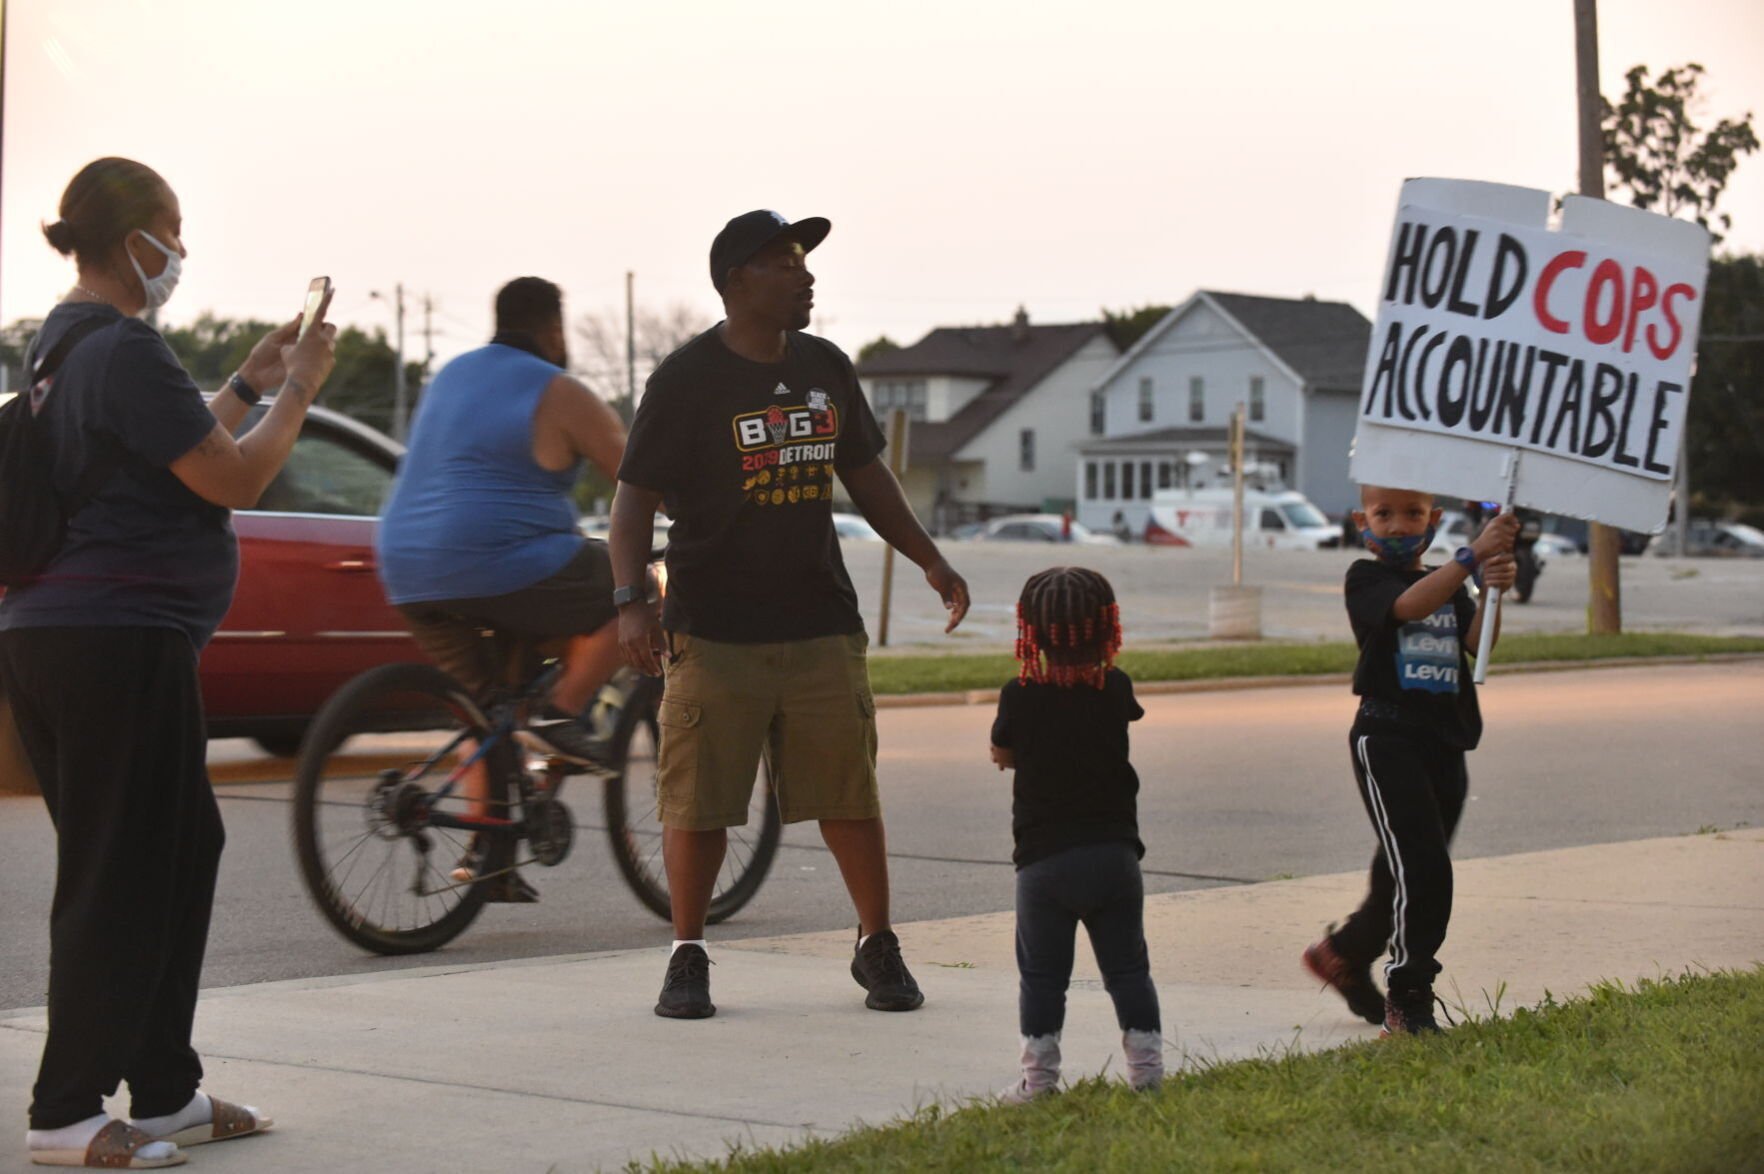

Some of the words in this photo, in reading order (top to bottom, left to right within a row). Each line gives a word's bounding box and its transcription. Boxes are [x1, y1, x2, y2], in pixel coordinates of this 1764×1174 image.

[1385, 222, 1529, 320] HOLD
[1532, 250, 1697, 361] COPS
[779, 443, 835, 465] DETROIT
[1364, 321, 1683, 475] ACCOUNTABLE
